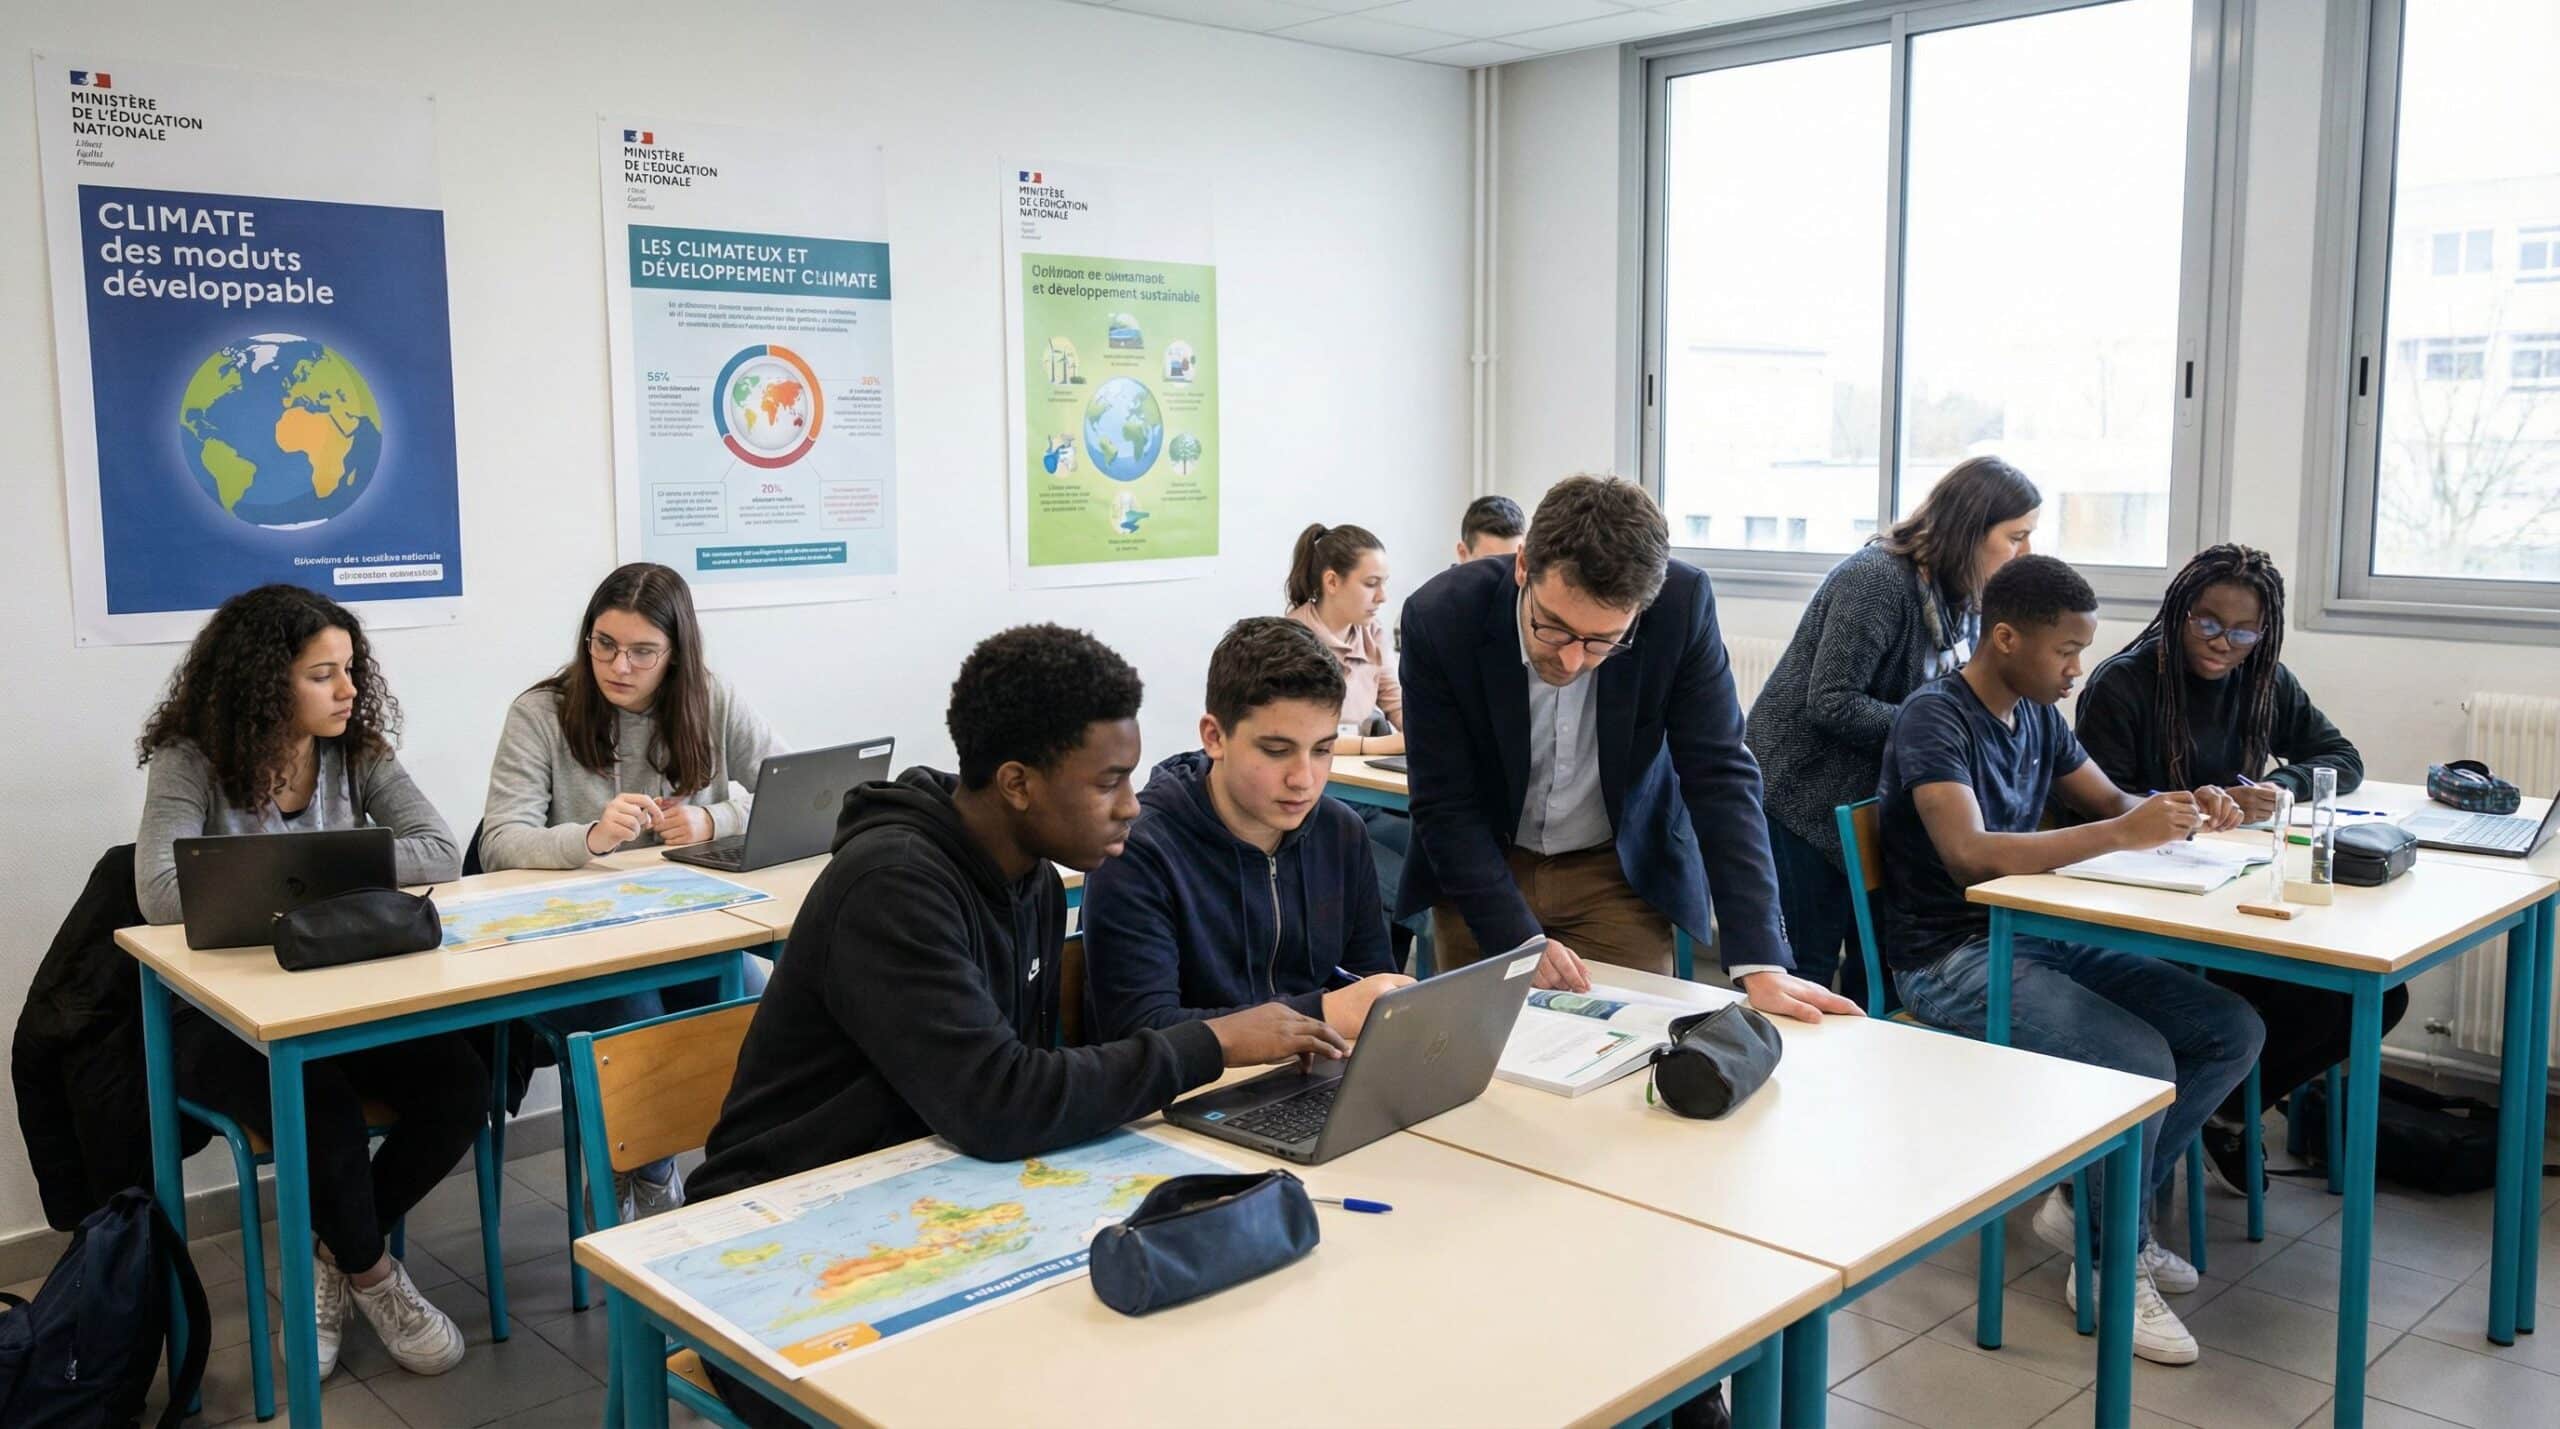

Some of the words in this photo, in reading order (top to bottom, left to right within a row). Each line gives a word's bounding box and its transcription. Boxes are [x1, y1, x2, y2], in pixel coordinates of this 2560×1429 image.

[71, 91, 157, 111] MINISTÈRE
[72, 107, 93, 120] DE
[98, 108, 203, 130] L'ÉDUCATION
[73, 122, 166, 141] NATIONALE
[625, 160, 640, 171] DE
[625, 173, 692, 187] NATIONALE
[98, 202, 256, 237] CLIMATE
[1020, 208, 1069, 220] NATIONALE
[101, 235, 162, 265] des
[173, 243, 301, 272] moduts
[640, 238, 671, 256] LES
[677, 241, 783, 263] CLIMATEUX
[788, 248, 808, 265] ET
[641, 258, 796, 285] DÉVELOPPEMENT
[103, 268, 335, 309] développable
